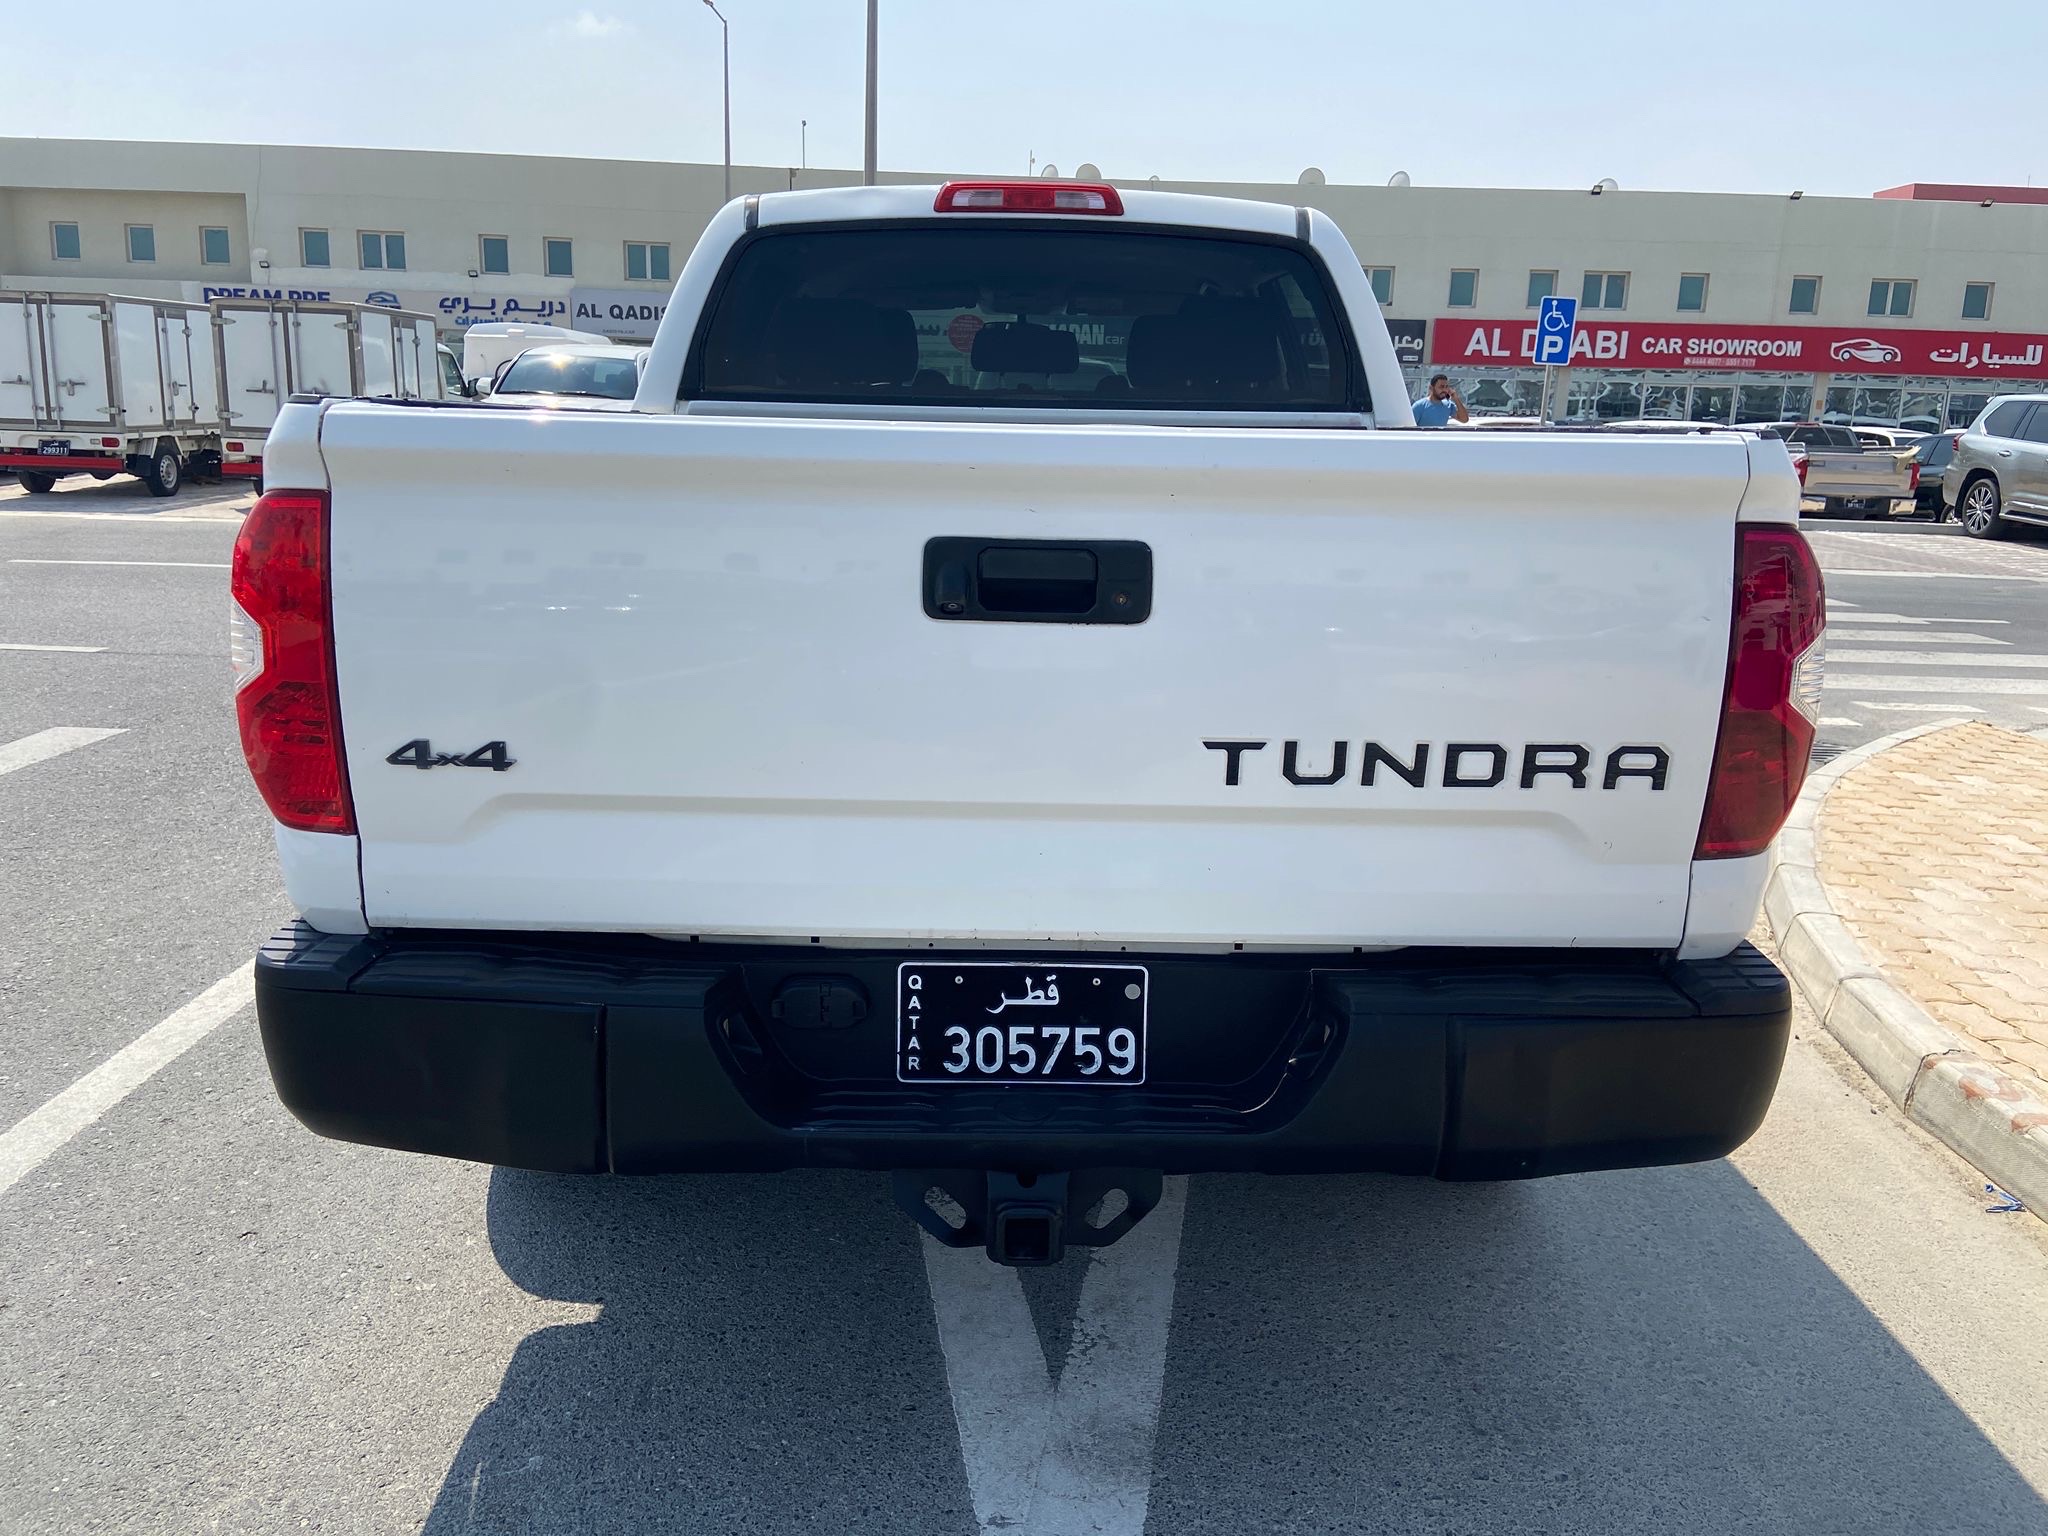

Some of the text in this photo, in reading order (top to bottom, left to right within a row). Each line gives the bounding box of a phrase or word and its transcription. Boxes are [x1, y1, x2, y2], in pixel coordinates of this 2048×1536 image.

[576, 303, 602, 318] AL
[1463, 327, 1802, 360] AL DABI CAR SHOWROOM
[1541, 335, 1563, 361] P
[1929, 342, 2043, 369] للسيارات
[385, 738, 518, 772] 4x4
[1200, 739, 1672, 792] TUNDRA
[985, 974, 1060, 1014] قطر
[907, 974, 922, 1071] QATAR
[943, 1026, 1136, 1076] 305759
